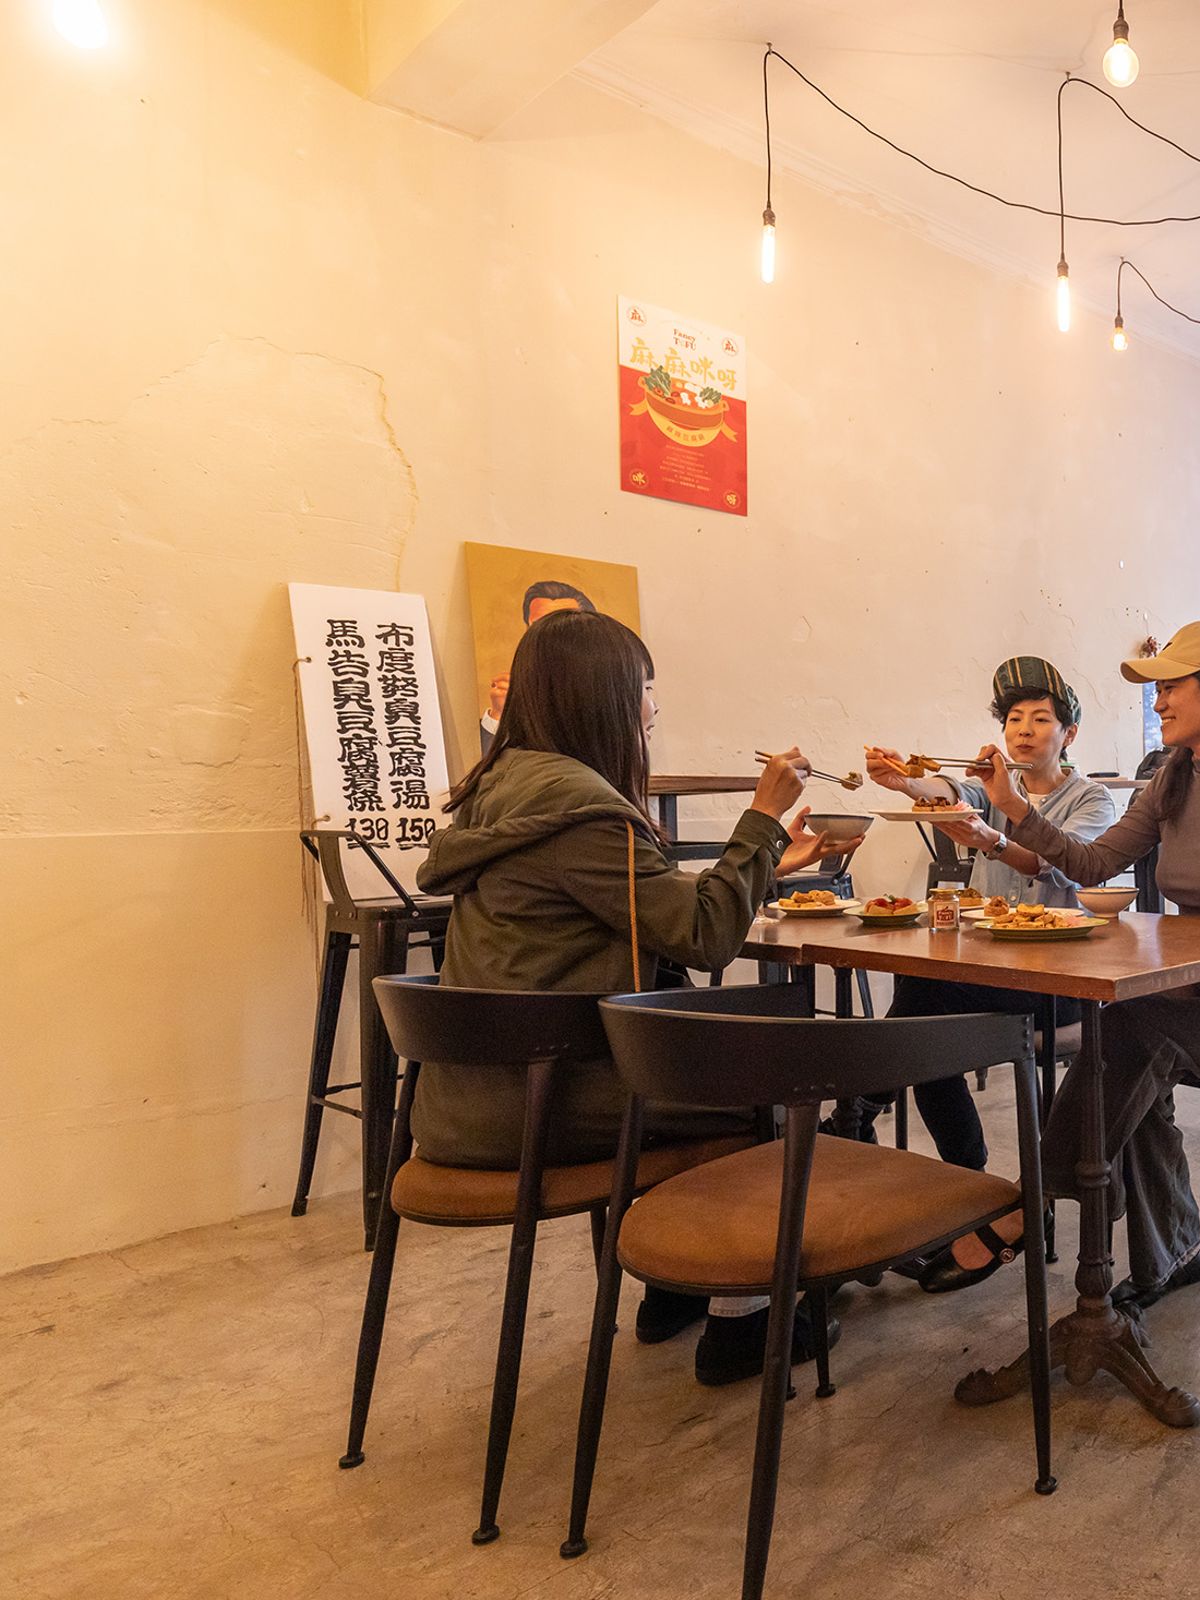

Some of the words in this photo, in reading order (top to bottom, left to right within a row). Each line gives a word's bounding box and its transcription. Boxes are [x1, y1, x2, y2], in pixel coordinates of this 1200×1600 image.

[629, 336, 737, 391] 麻麻咪呀
[344, 817, 390, 842] 130
[396, 817, 436, 843] 150
